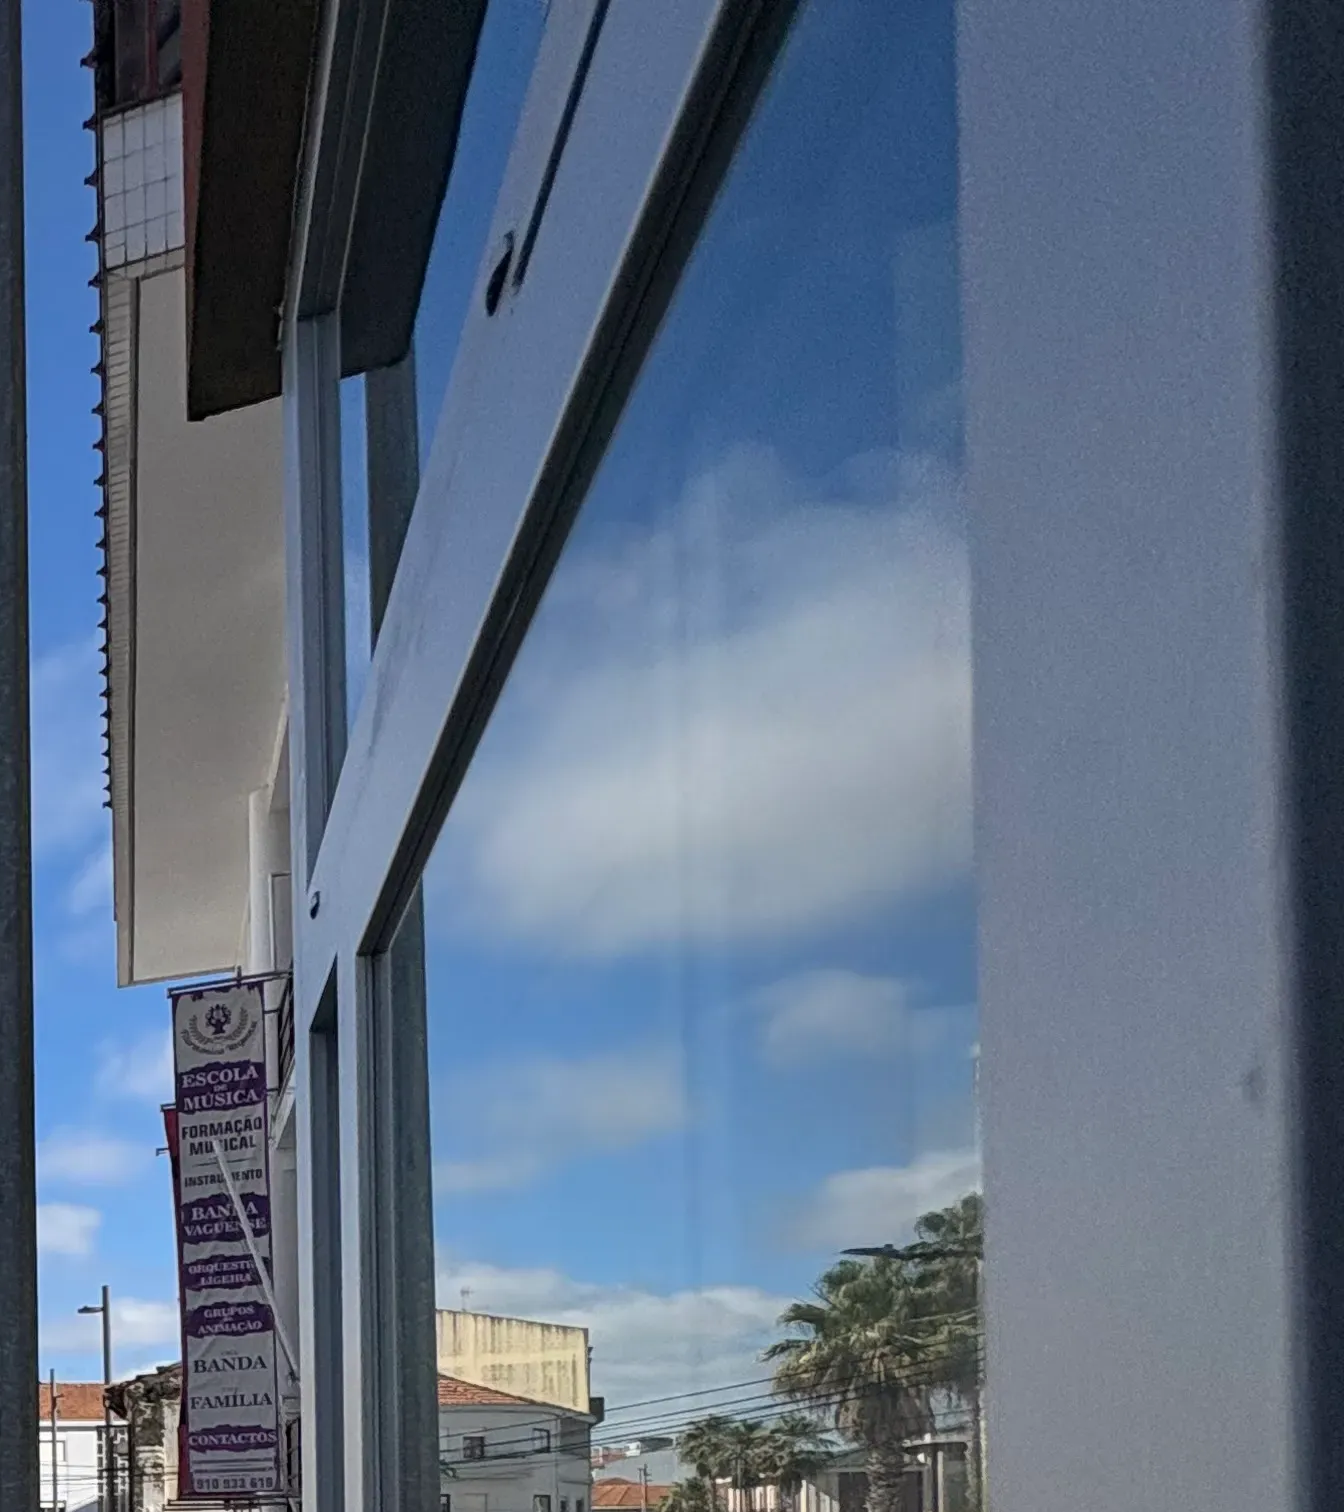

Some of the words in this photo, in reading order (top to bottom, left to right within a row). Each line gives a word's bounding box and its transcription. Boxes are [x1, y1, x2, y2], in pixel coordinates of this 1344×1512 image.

[182, 1065, 259, 1088] ESCOLA
[183, 1088, 260, 1111] MÚSICA
[182, 1115, 263, 1140] FORMAÇÃO
[189, 1136, 257, 1156] MUICAL
[184, 1169, 263, 1188] INSTRUENTO
[200, 1273, 252, 1285] LIGEIRA
[203, 1305, 256, 1318] GRUPOS
[197, 1320, 263, 1335] ANIMAÇÃO
[193, 1355, 268, 1374] BANDA
[189, 1390, 273, 1410] FAMÍLIA
[188, 1431, 277, 1446] CONTACTOS
